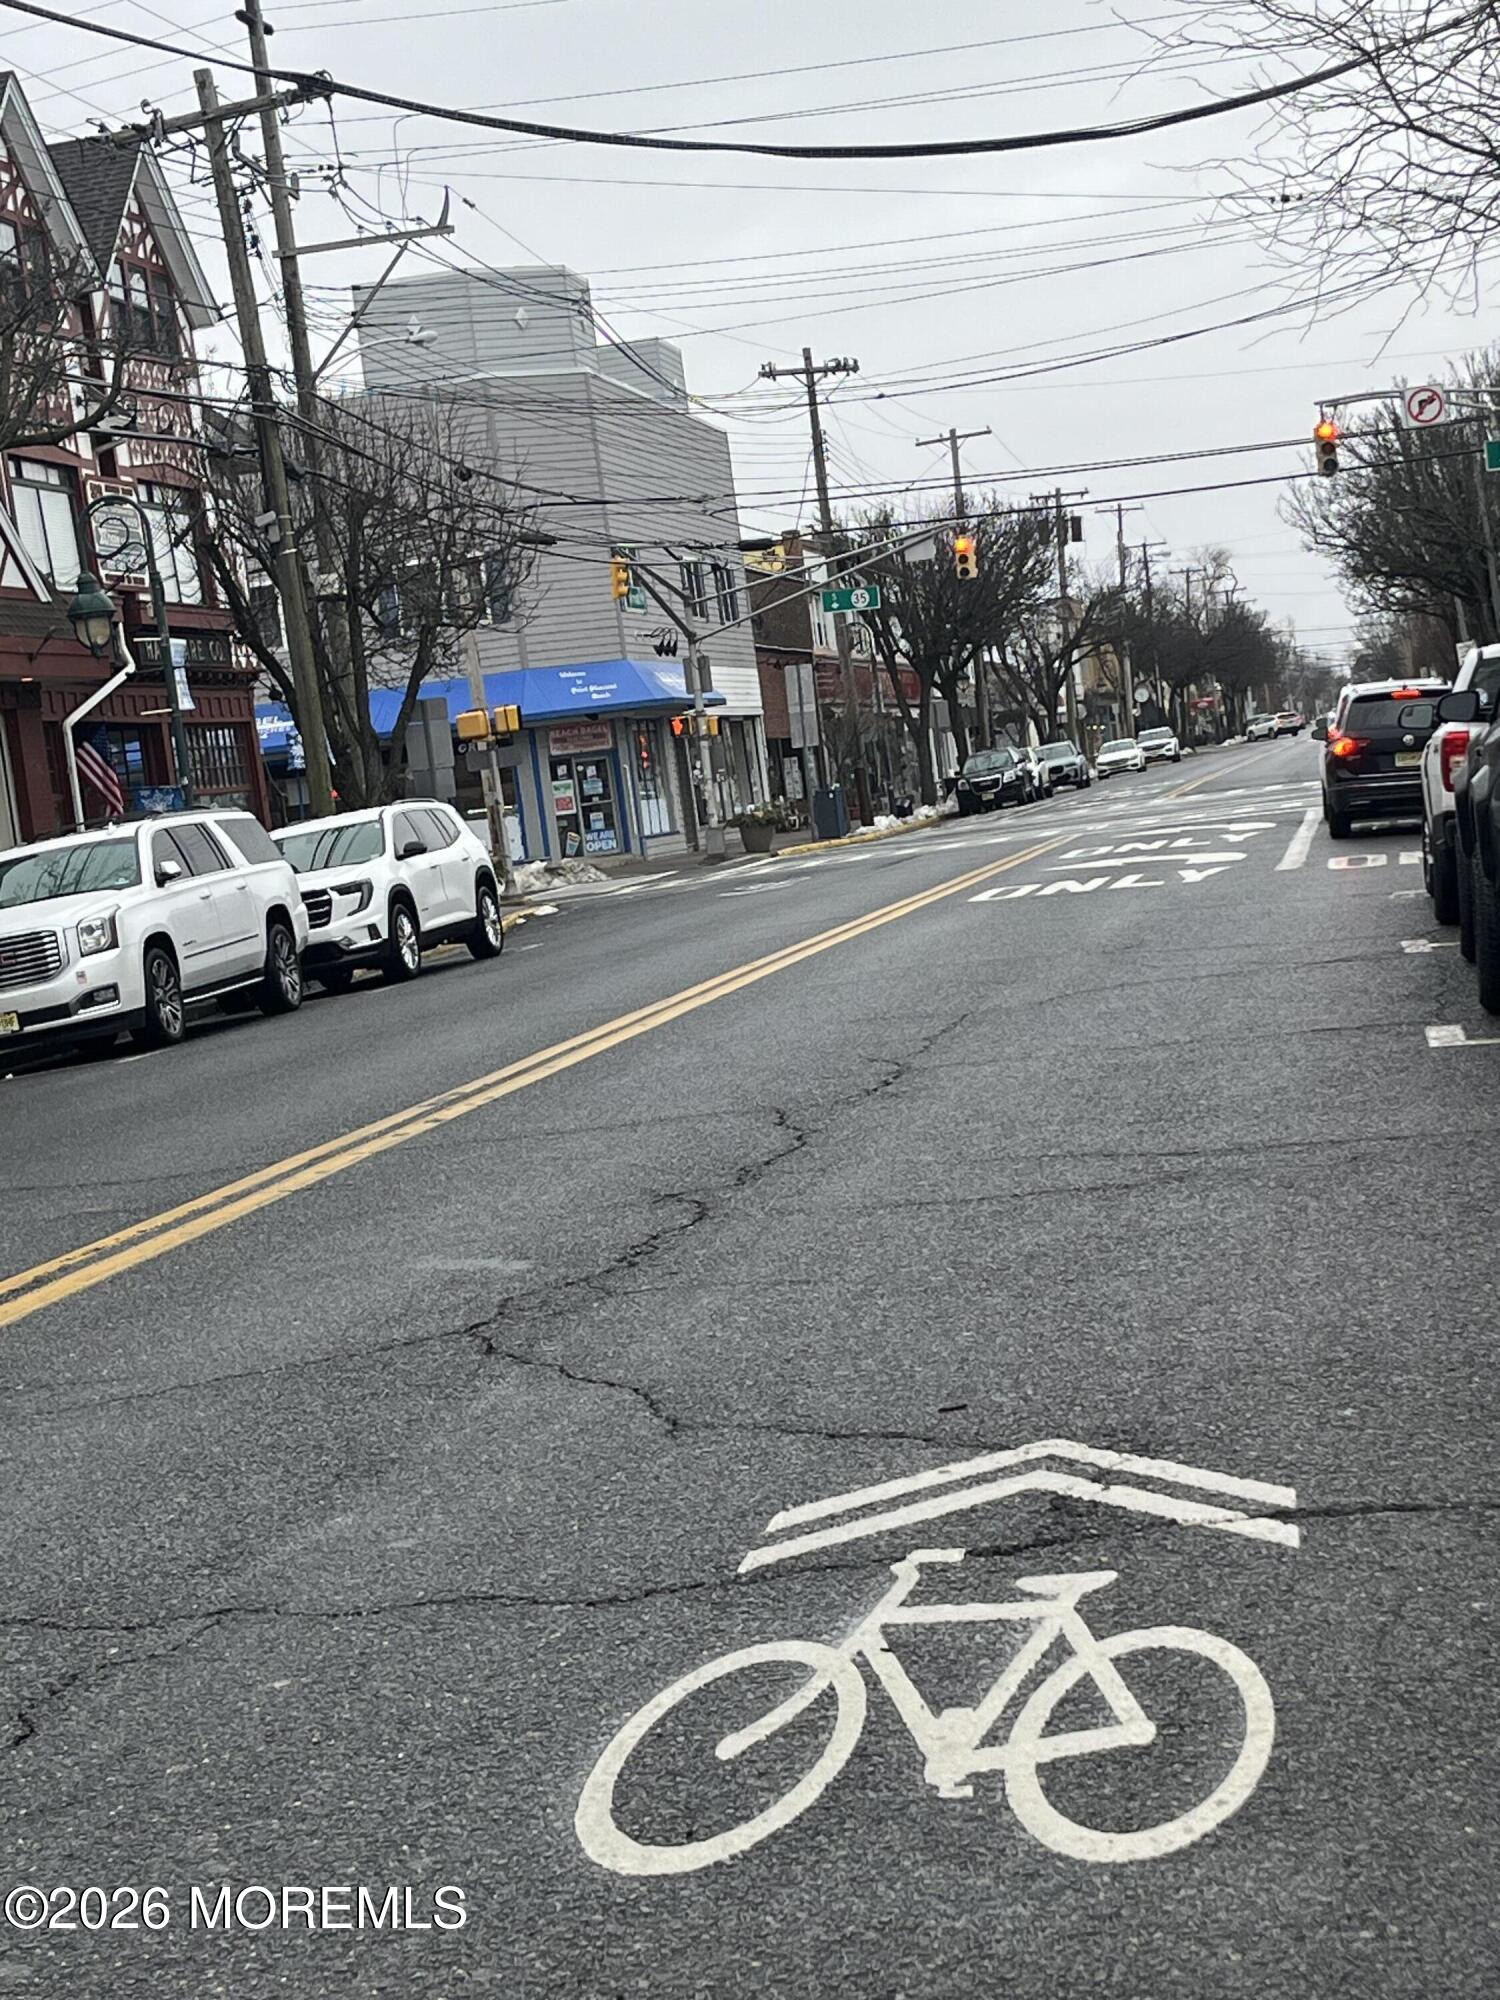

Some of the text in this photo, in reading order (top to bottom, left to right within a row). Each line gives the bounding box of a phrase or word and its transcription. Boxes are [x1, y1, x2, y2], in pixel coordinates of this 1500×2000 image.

[853, 593, 868, 605] 35
[586, 839, 618, 852] OPEN
[1058, 831, 1261, 860] ONLY
[967, 865, 1233, 902] ONLY
